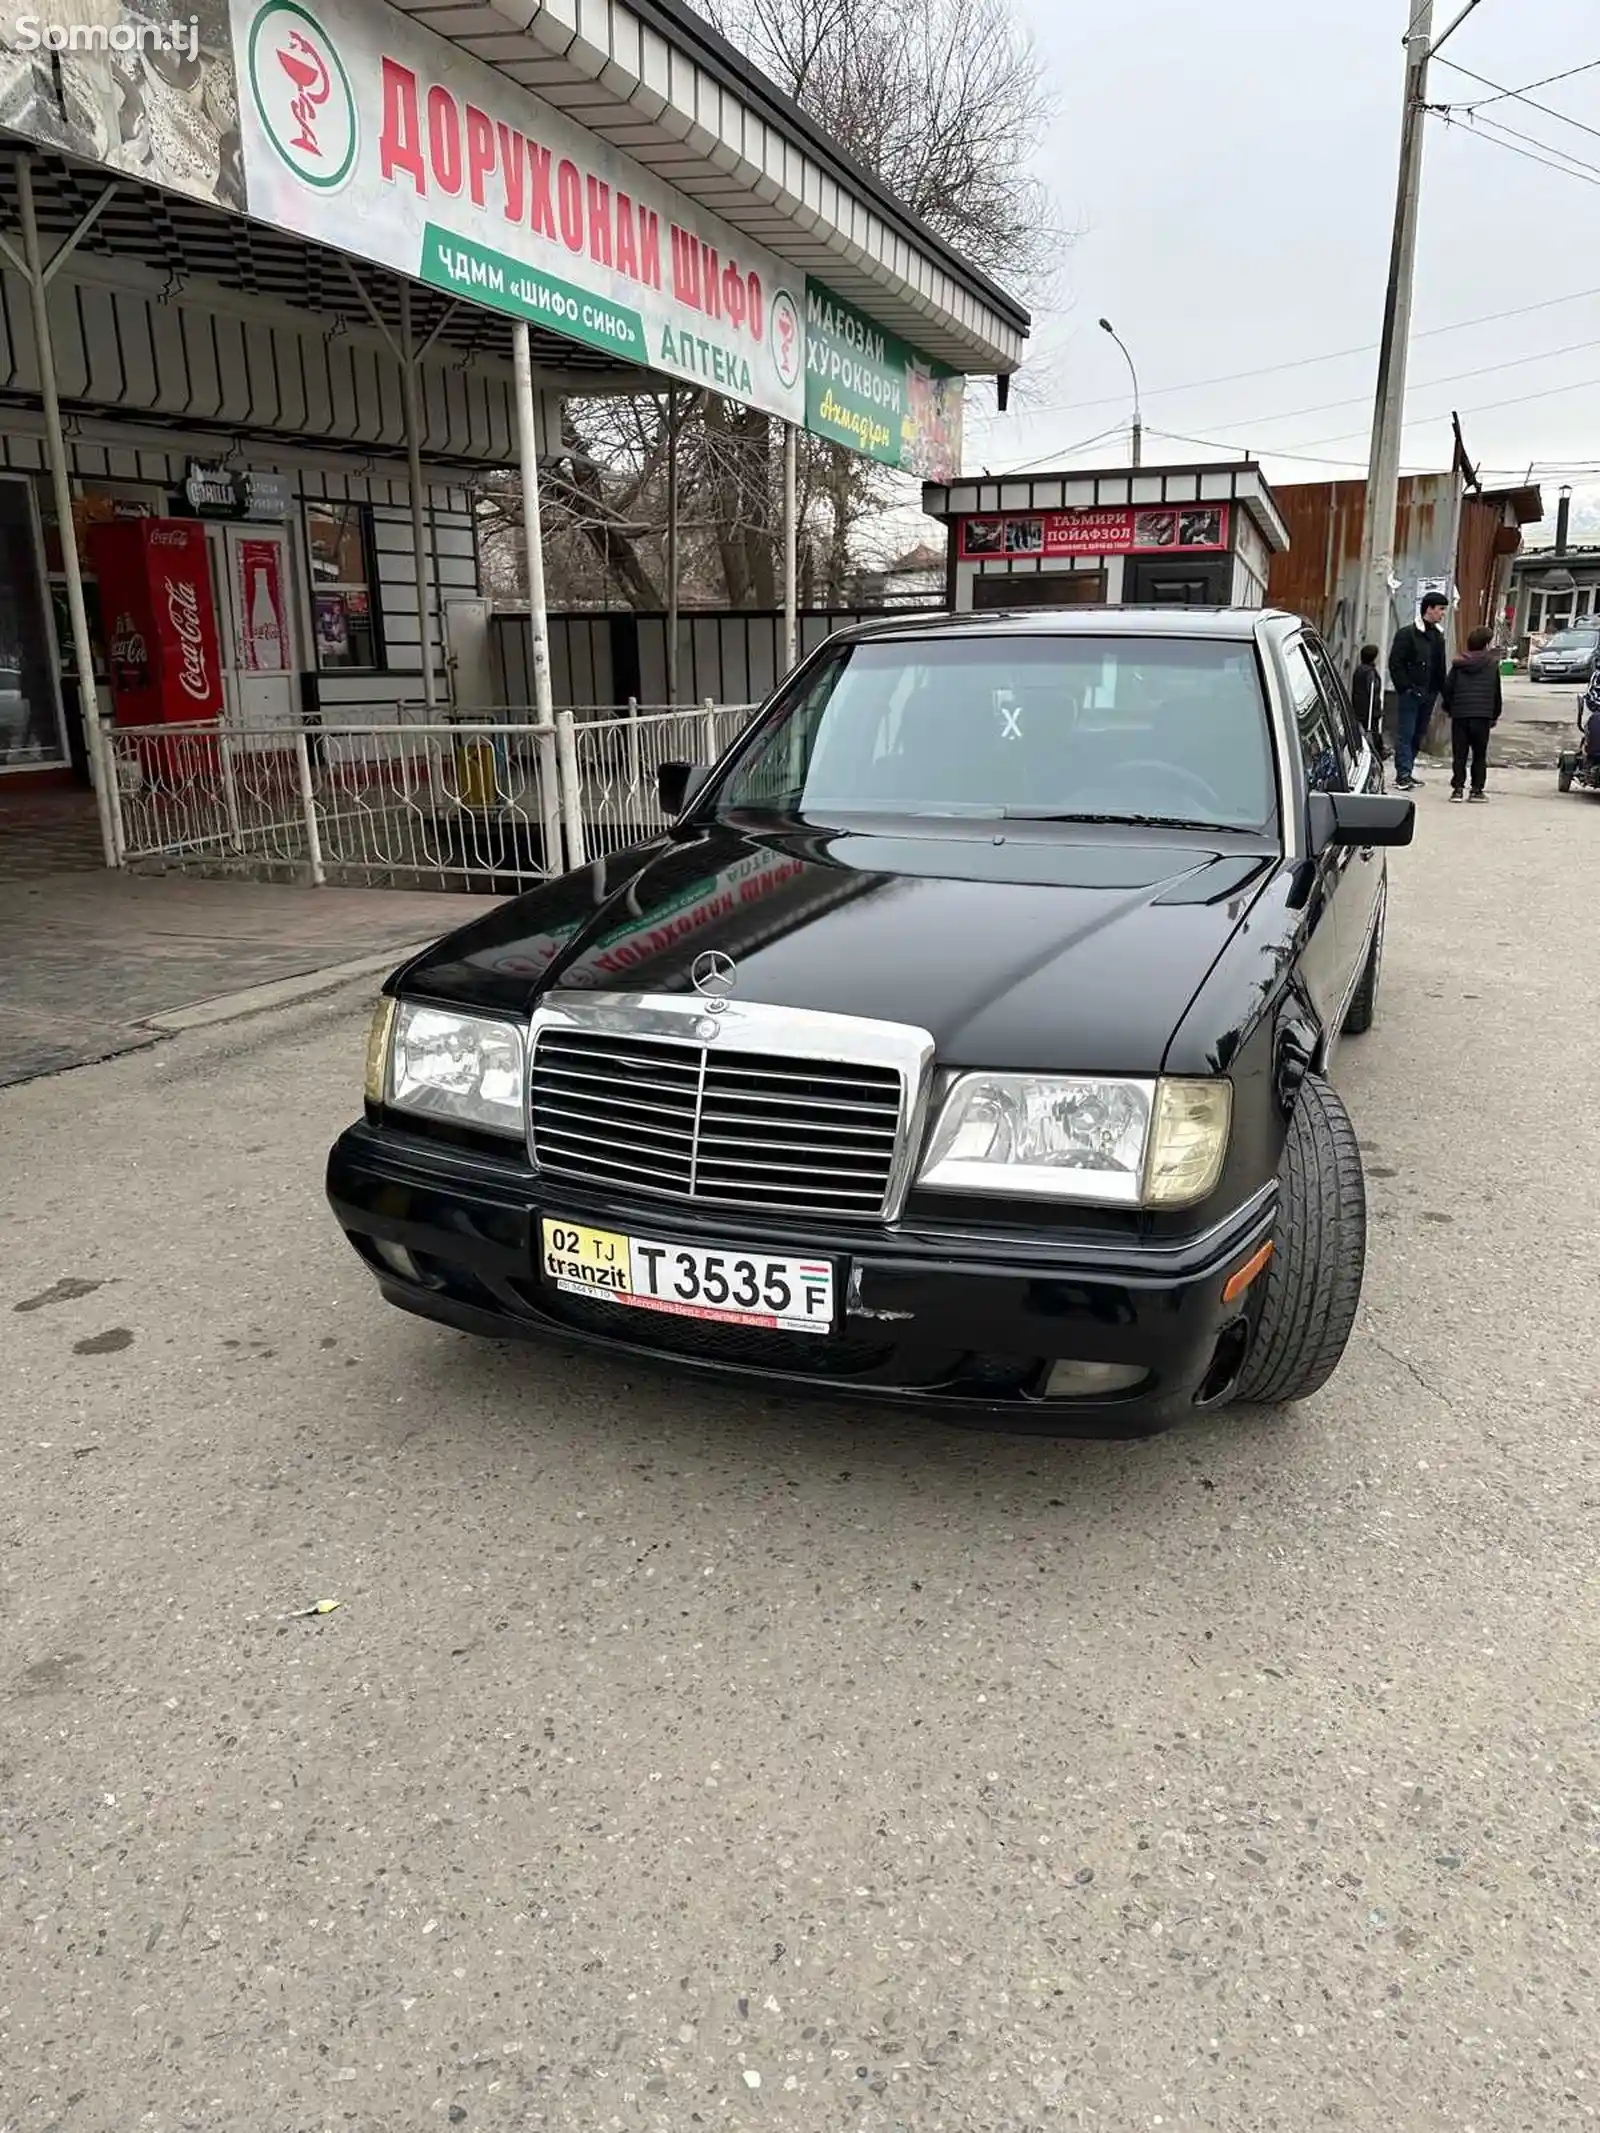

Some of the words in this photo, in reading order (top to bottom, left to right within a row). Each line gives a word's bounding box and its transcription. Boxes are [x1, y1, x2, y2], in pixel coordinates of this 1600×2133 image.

[378, 55, 662, 292] ДОРУХОНАИ
[670, 224, 763, 342] ШИФО
[660, 324, 752, 395] АПТЕКА
[1052, 513, 1127, 527] ТАЪМИРИ
[552, 1228, 580, 1254] 02
[592, 1239, 616, 1262] TJ
[547, 1253, 628, 1290] tranzit
[805, 1286, 826, 1314] F
